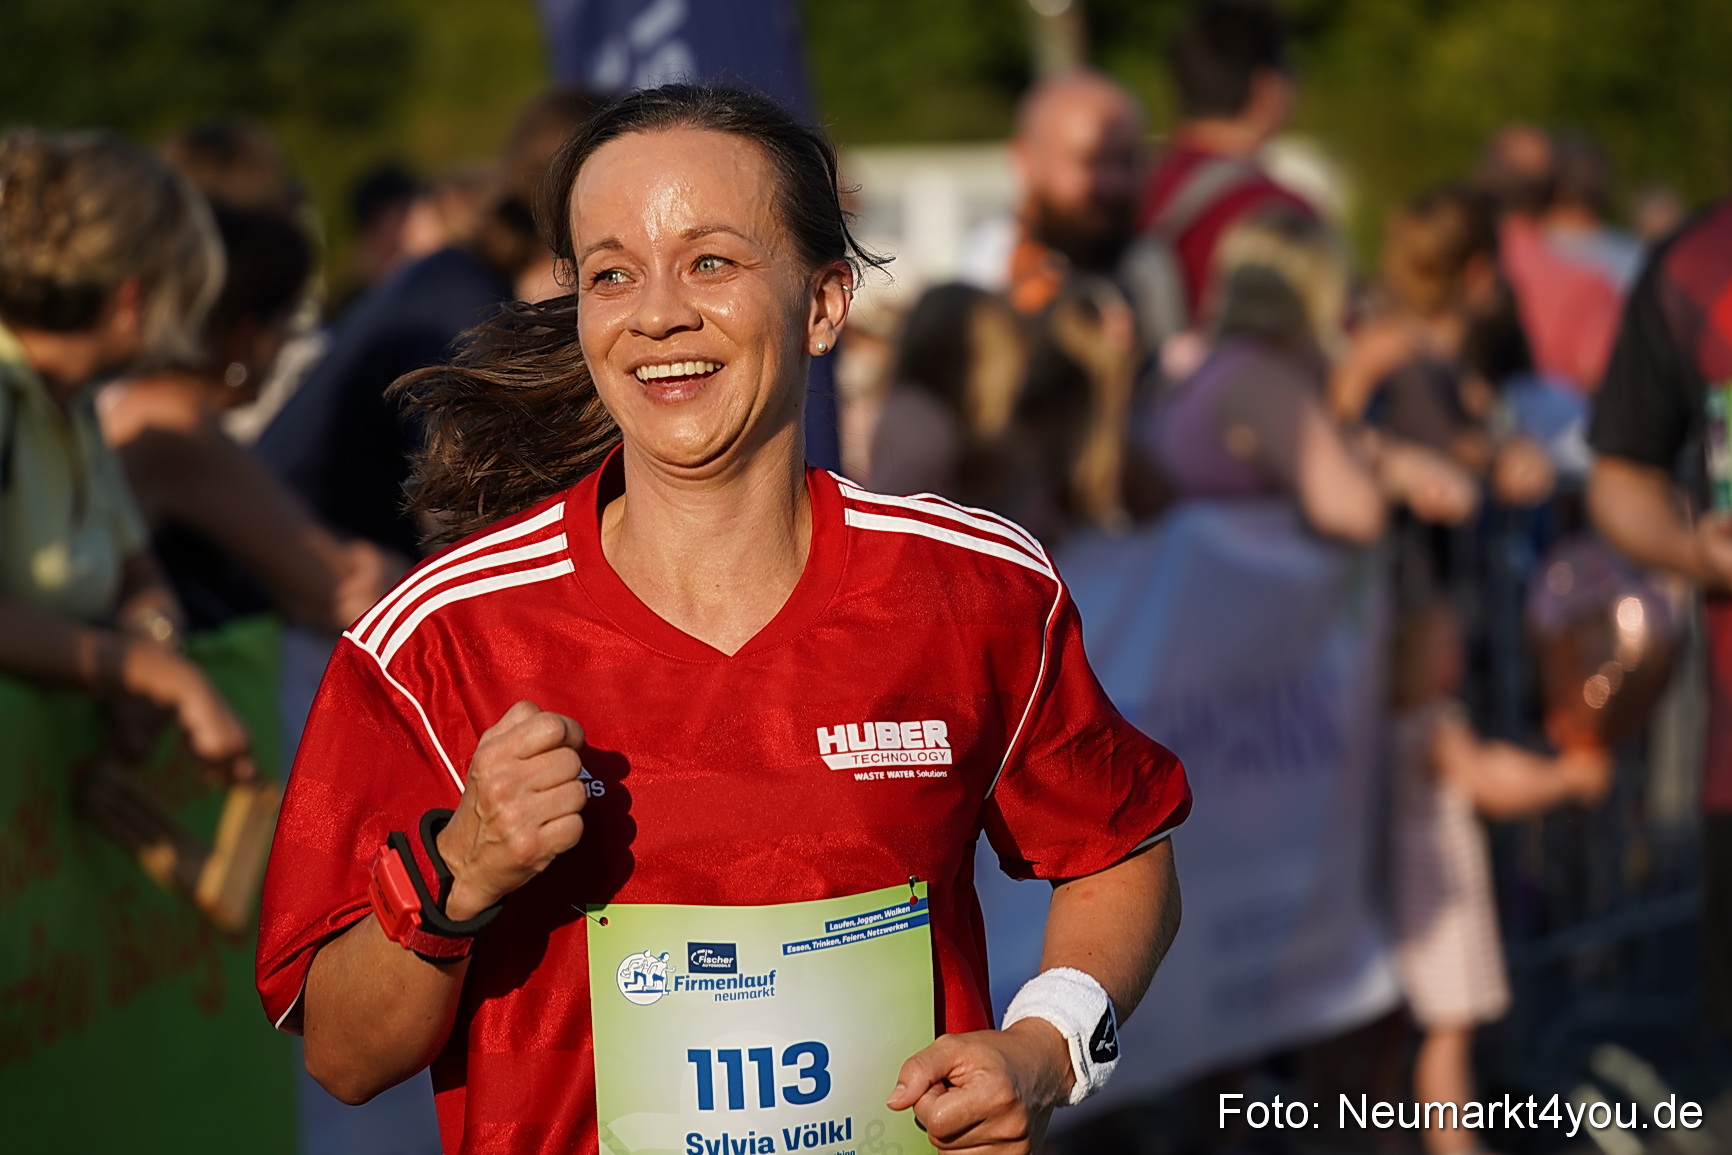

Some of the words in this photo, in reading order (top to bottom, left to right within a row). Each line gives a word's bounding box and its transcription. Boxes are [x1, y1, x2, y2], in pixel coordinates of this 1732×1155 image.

[816, 720, 951, 755] HUBER
[851, 751, 947, 765] TECHNOLOGY
[854, 771, 885, 781] WASTE
[886, 769, 915, 779] WATER
[916, 768, 948, 778] Solutions
[829, 919, 857, 931] Laufen,
[856, 913, 884, 926] Joggen,
[884, 905, 911, 918] Walken
[787, 942, 811, 953] Essen,
[812, 936, 841, 949] Trinken,
[842, 931, 867, 943] Feiern,
[867, 921, 909, 937] Netzwerken
[674, 969, 777, 991] Firmenlauf
[714, 987, 776, 1002] neumarkt
[687, 1041, 831, 1111] 1113
[686, 1131, 776, 1155] Sylvia
[782, 1117, 853, 1151] Völkl
